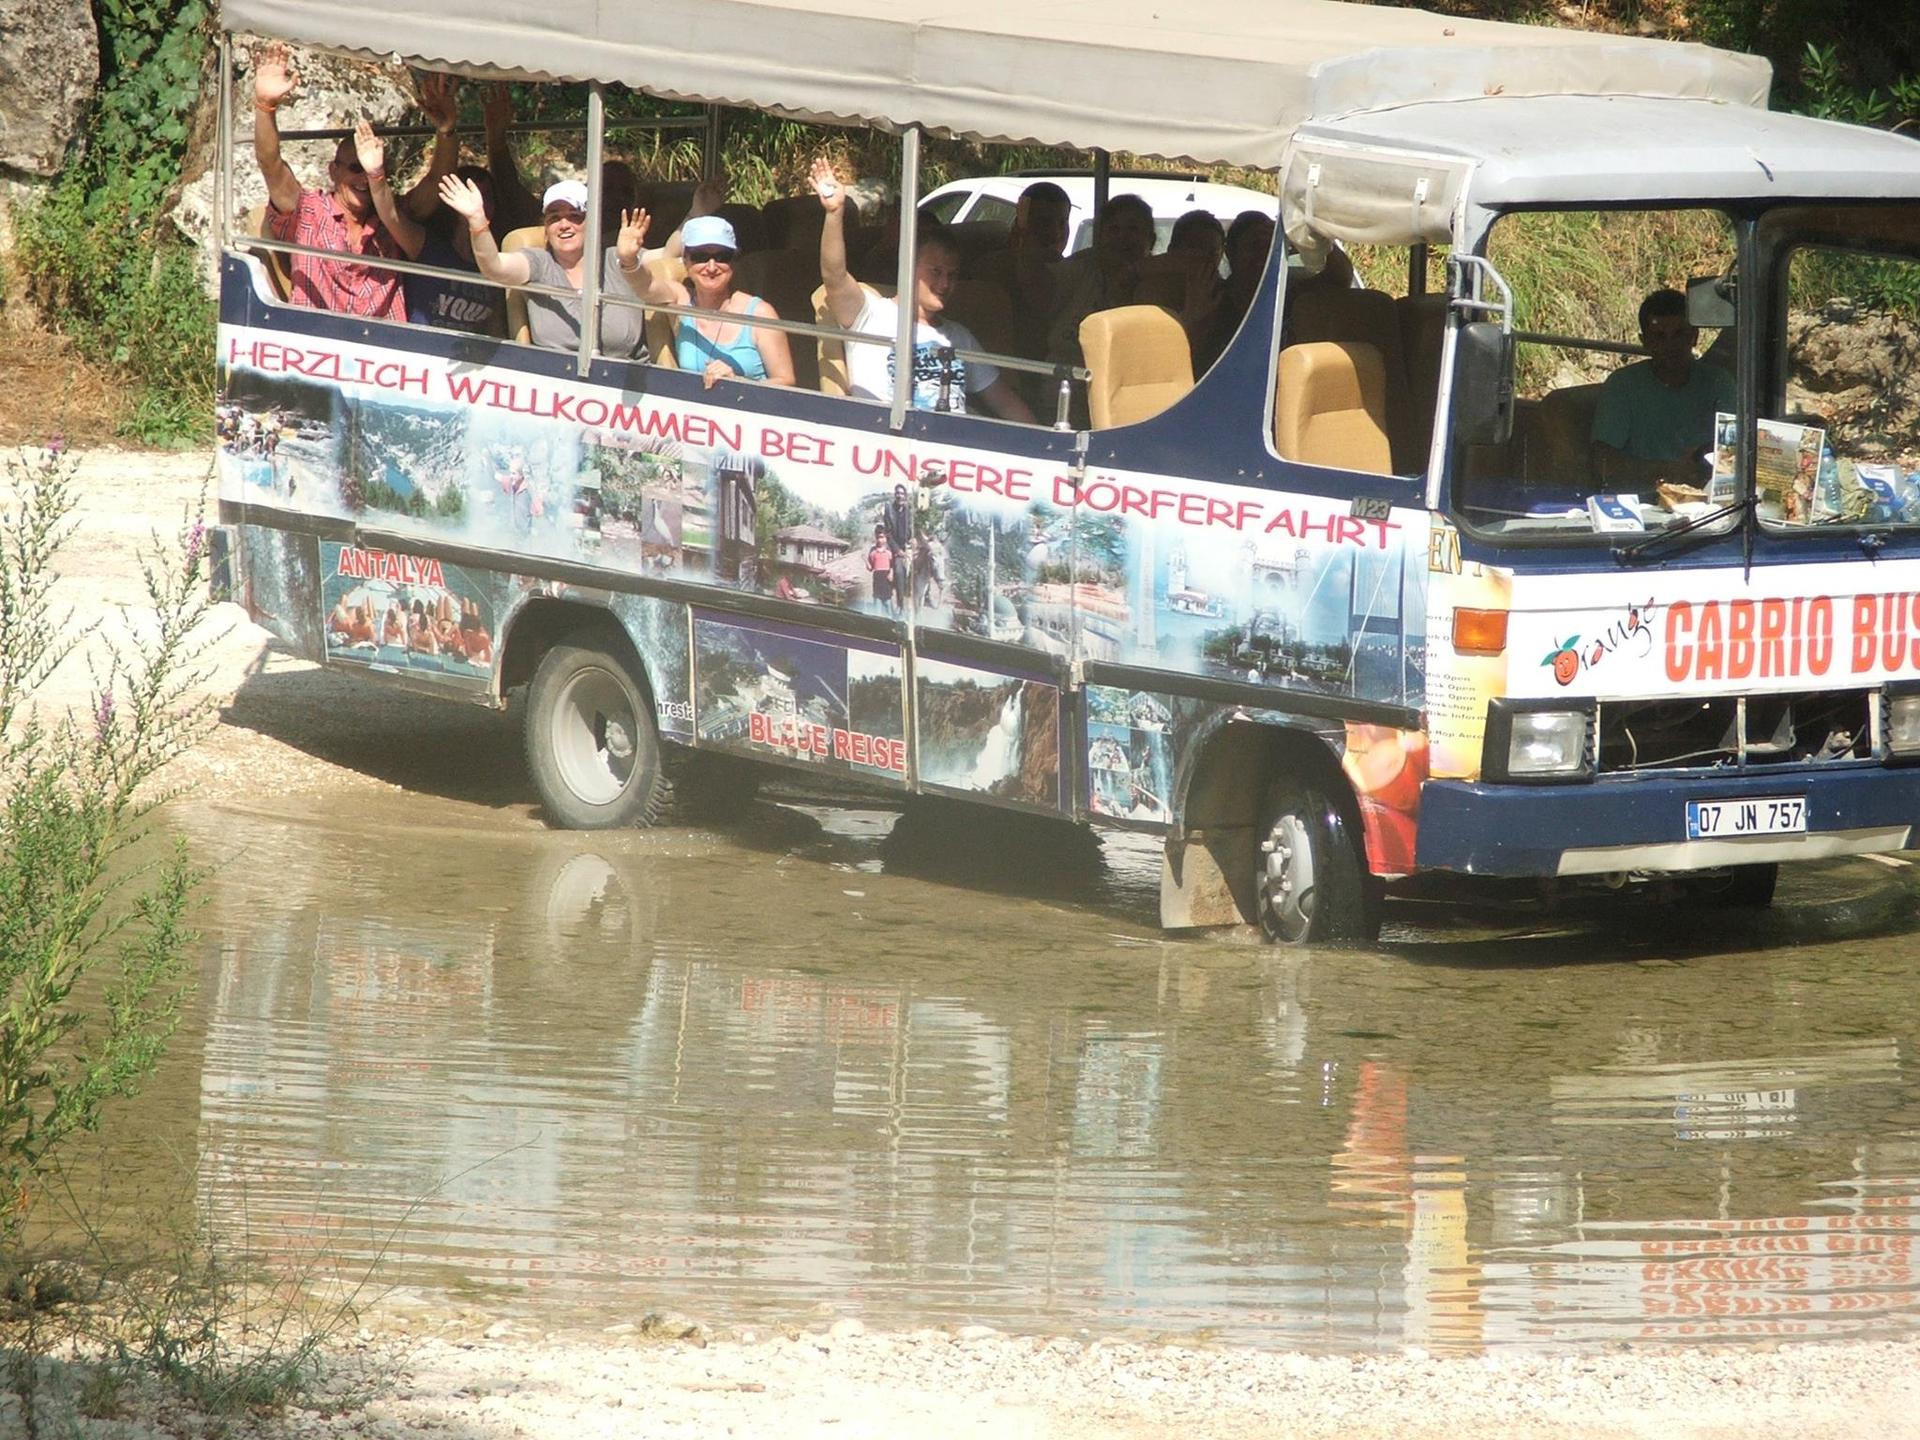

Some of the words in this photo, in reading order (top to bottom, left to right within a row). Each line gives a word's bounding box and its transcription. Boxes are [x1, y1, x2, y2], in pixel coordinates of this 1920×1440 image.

[230, 338, 428, 394] HERZLICH
[446, 373, 742, 451] WILLKOMMEN
[761, 428, 835, 466] BEI
[1053, 474, 1402, 549] DÖRFERFAHRT
[1350, 497, 1389, 519] M23
[337, 546, 446, 588] ANTALYA
[1665, 595, 1833, 683] CABRIO
[834, 728, 906, 772] REISE
[1700, 806, 1721, 832] 07
[1736, 804, 1757, 831] JN
[1769, 802, 1802, 829] 757
